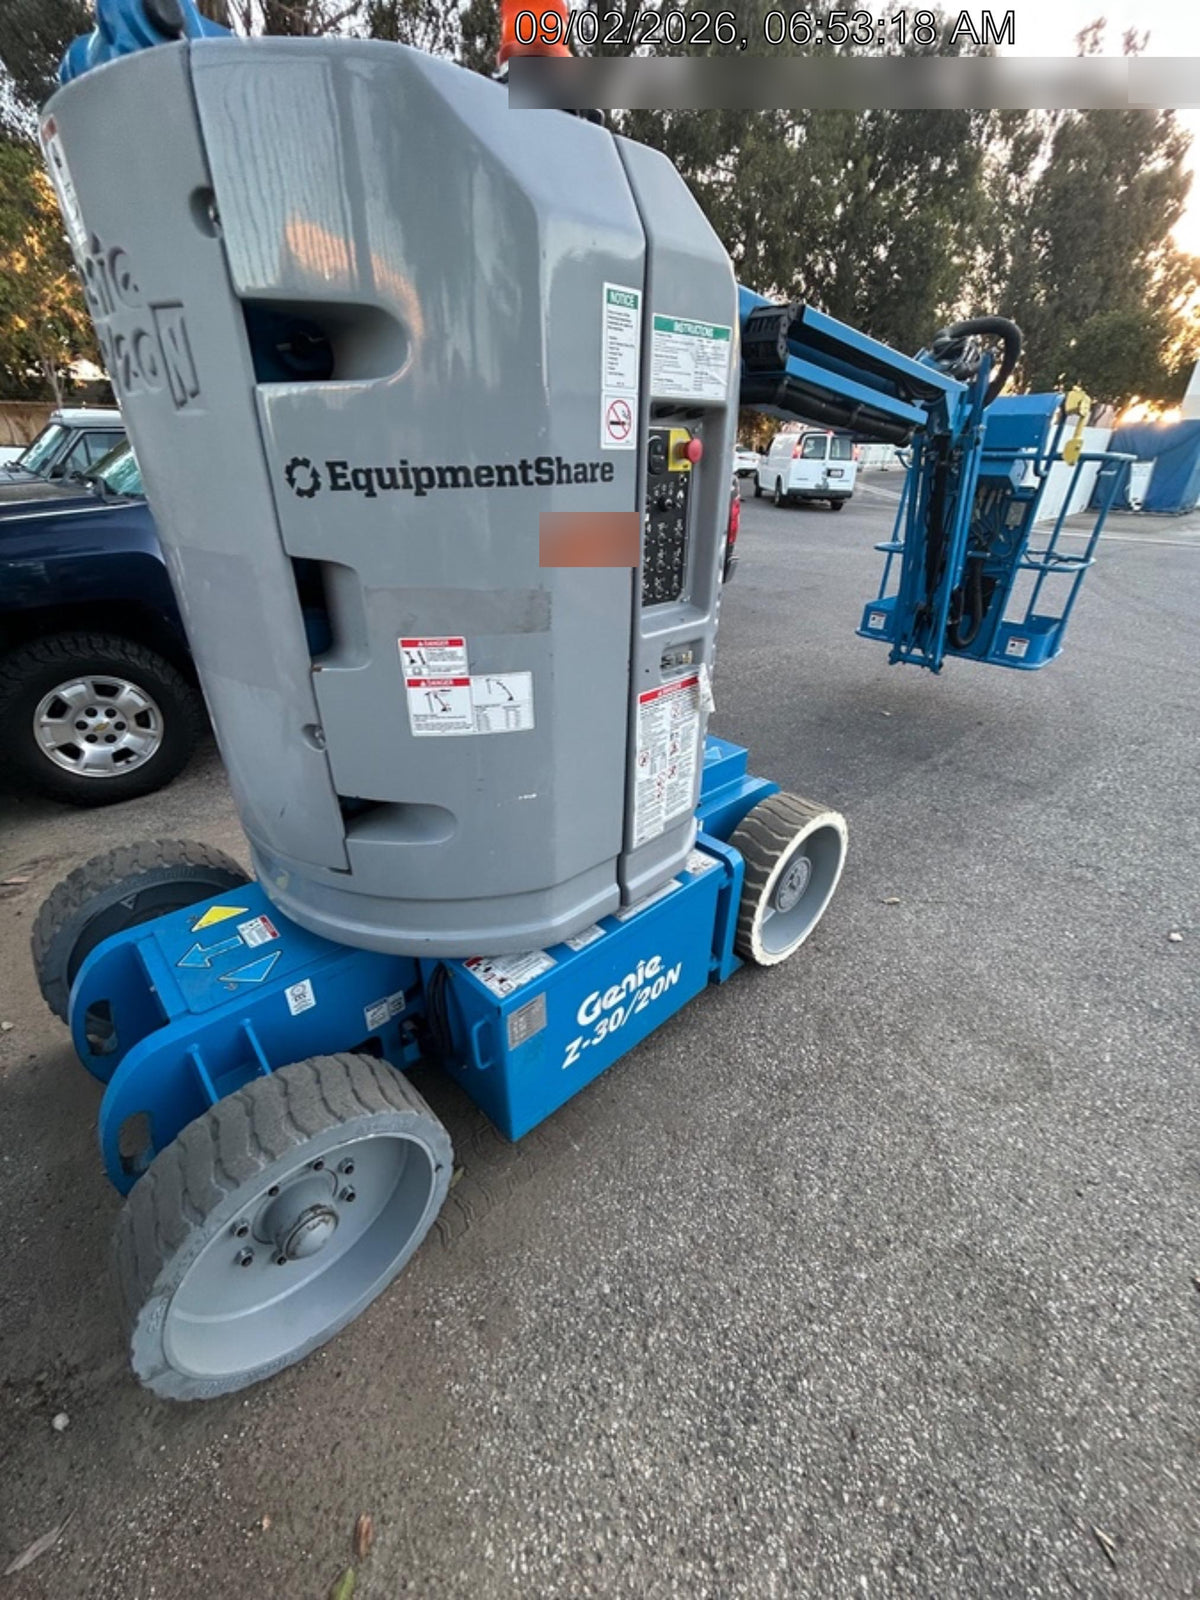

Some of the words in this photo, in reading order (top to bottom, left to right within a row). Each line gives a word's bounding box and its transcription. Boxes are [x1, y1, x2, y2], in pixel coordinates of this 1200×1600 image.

[609, 290, 635, 307] NOTICE
[325, 457, 615, 497] EquipmentShare
[562, 962, 682, 1070] Z-30/20N
[577, 955, 663, 1027] Genie
